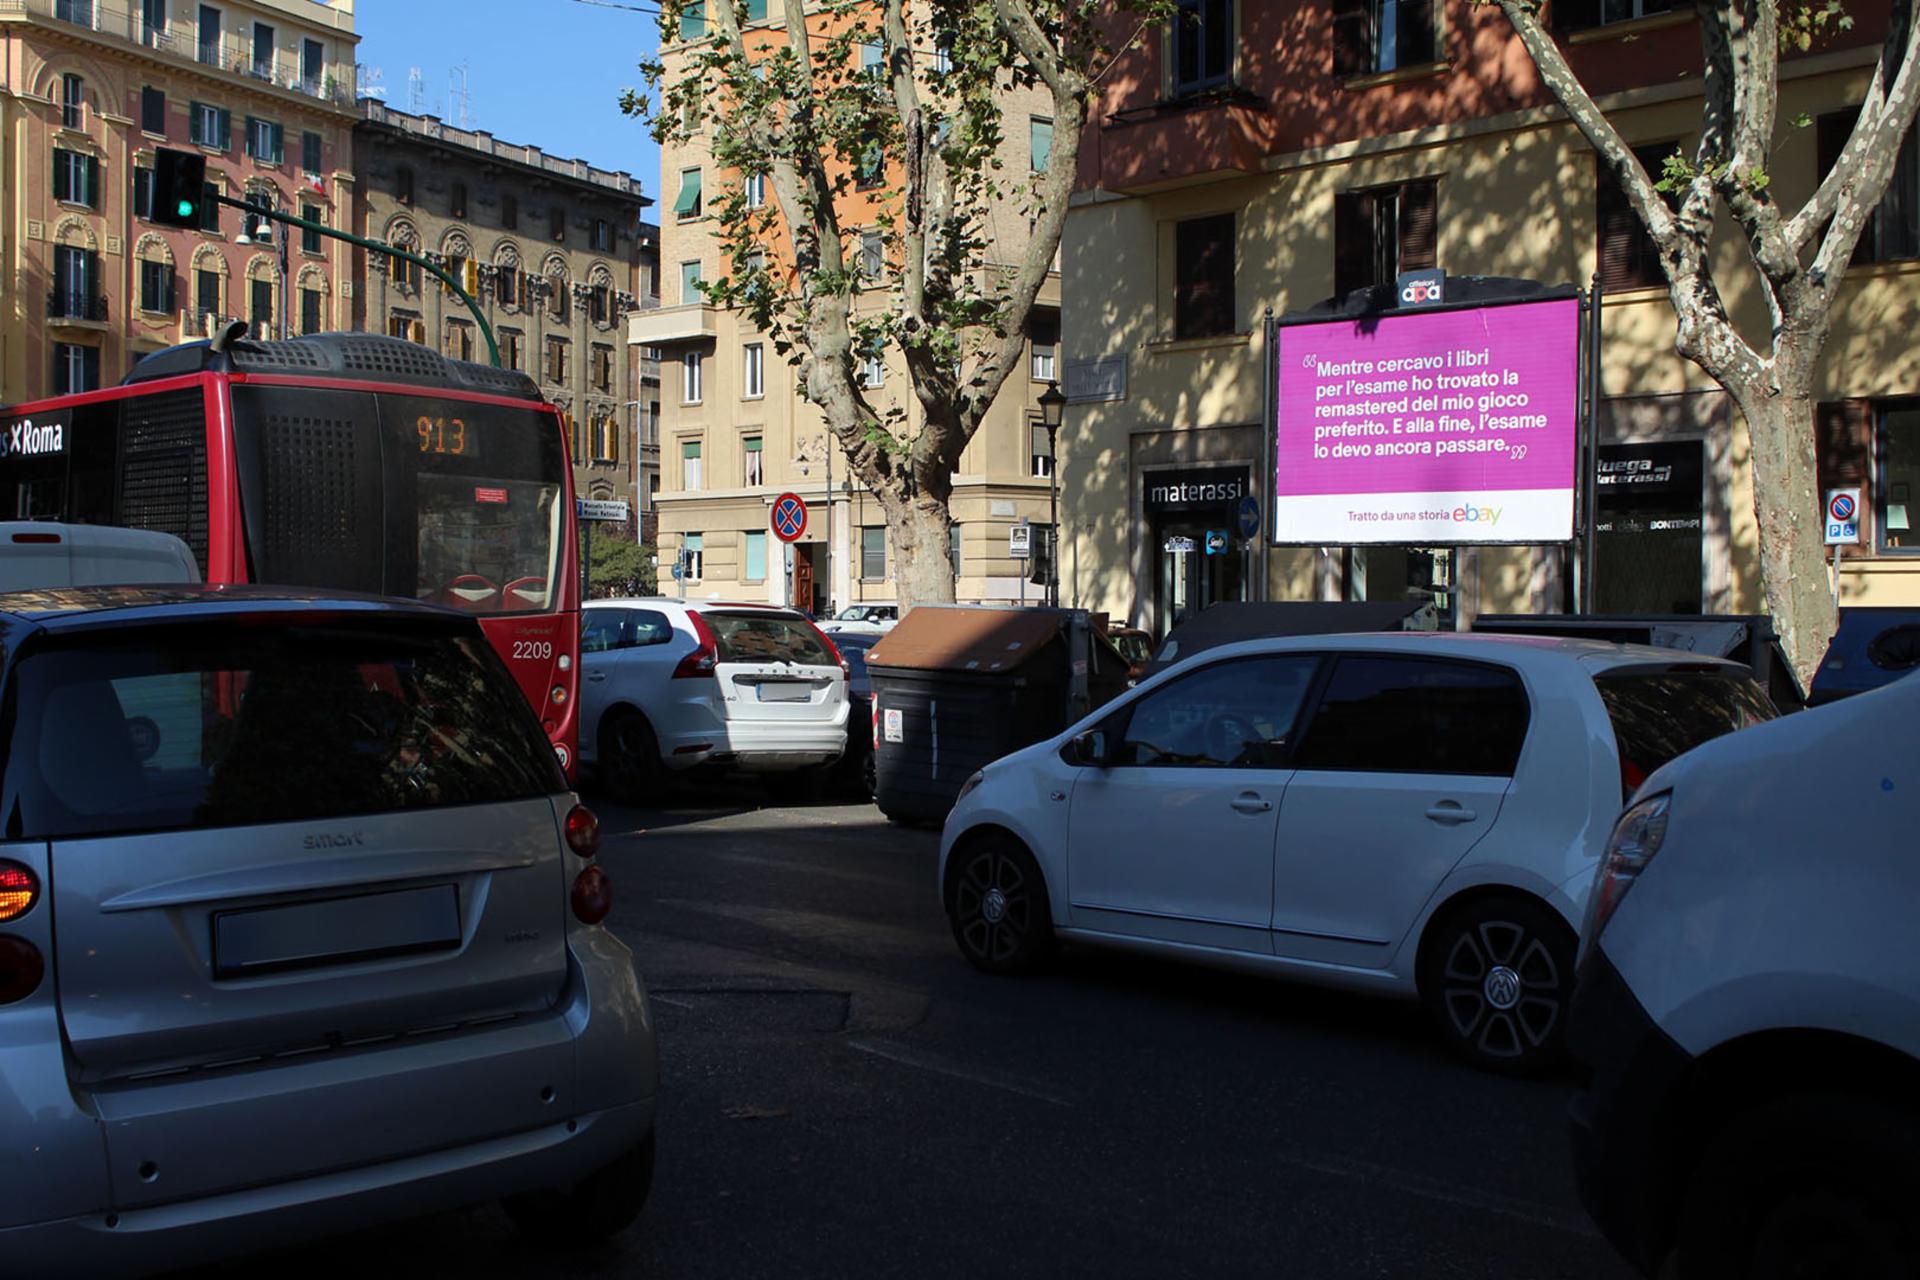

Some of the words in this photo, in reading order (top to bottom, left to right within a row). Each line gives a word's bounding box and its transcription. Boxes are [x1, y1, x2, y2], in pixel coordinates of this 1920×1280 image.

[1402, 286, 1440, 304] apa
[1377, 355, 1443, 373] cercavo
[1447, 351, 1452, 368] i
[1456, 348, 1489, 367] libri
[1316, 384, 1343, 401] per
[1346, 379, 1408, 396] l’esame
[1412, 375, 1433, 391] ho
[1437, 370, 1499, 389] trovato
[1503, 369, 1519, 385] la
[1315, 397, 1408, 418] remastered
[1411, 394, 1438, 412] del
[1442, 393, 1474, 410] mio
[1478, 391, 1528, 412] gioco
[416, 415, 465, 454] 913
[1314, 419, 1389, 441] preferito.
[1393, 418, 1402, 434] E
[1405, 416, 1434, 433] alla
[1438, 415, 1475, 434] fine,
[1479, 413, 1547, 430] l’esame
[1314, 443, 1329, 459] lo
[1331, 441, 1371, 458] devo
[1374, 441, 1431, 456] ancora
[1151, 477, 1242, 502] materassi
[1348, 511, 1378, 521] Tratto
[1381, 510, 1394, 521] da
[1396, 511, 1416, 521] una
[1418, 509, 1450, 521] storia
[1453, 503, 1502, 526] ebay
[513, 641, 552, 659] 2209
[303, 832, 363, 849] smart
